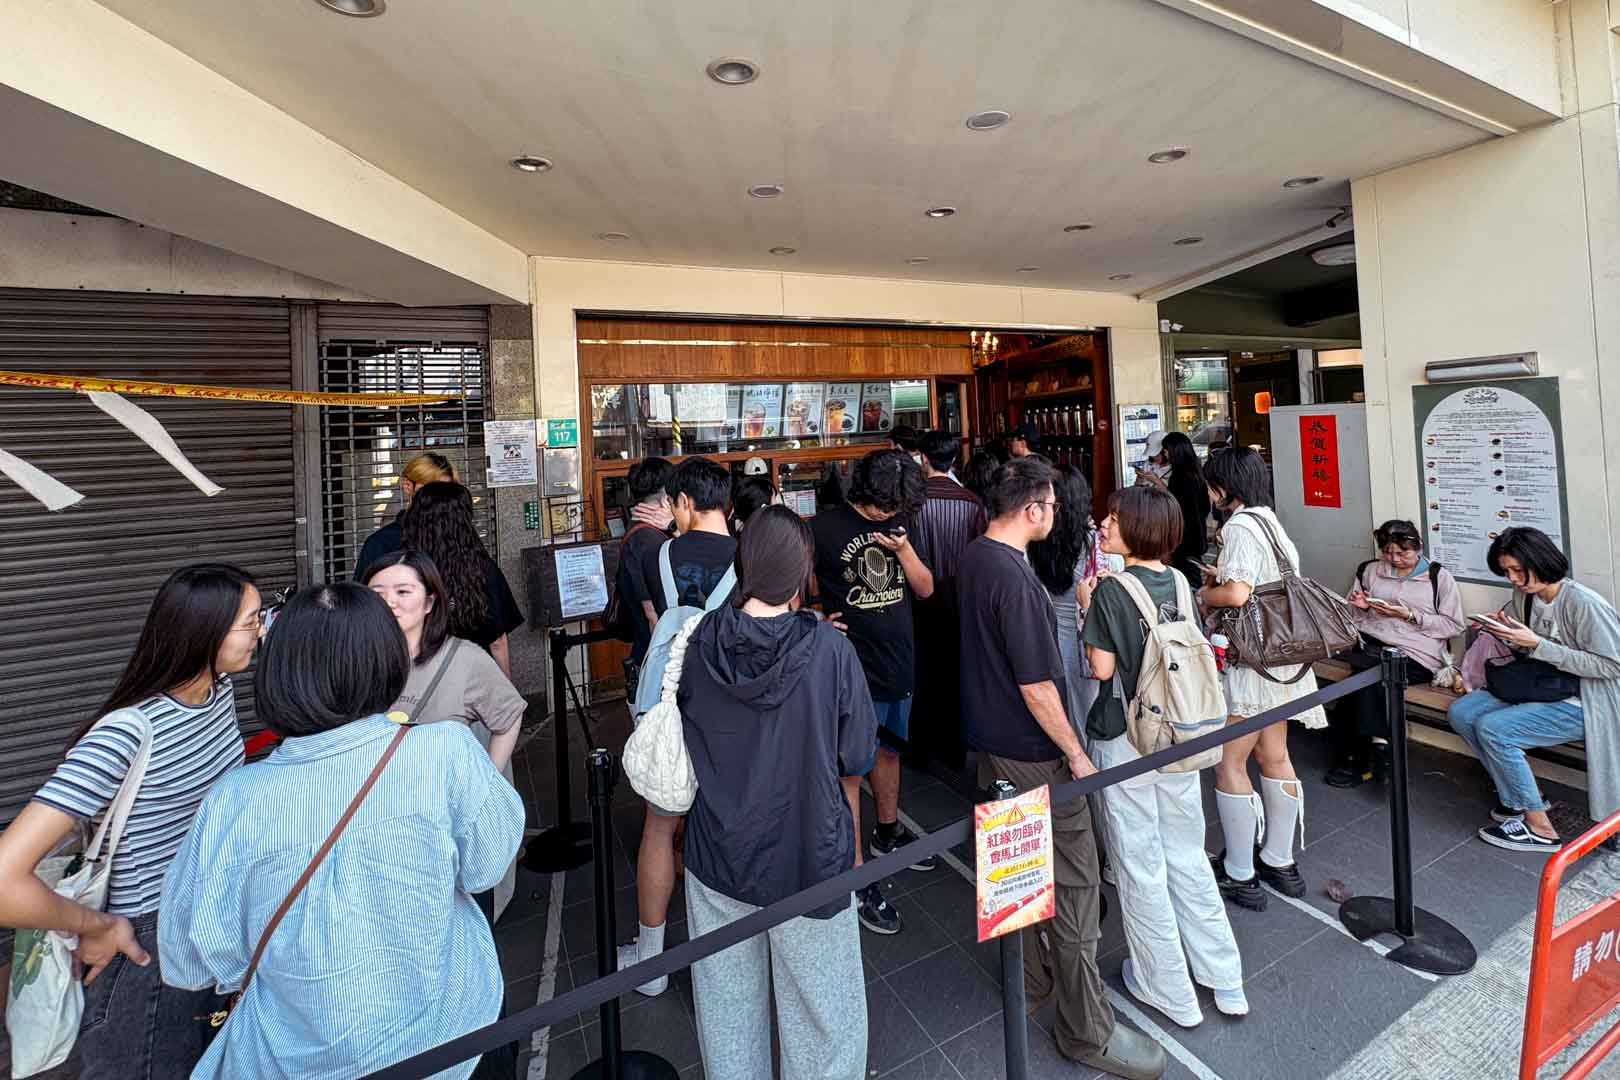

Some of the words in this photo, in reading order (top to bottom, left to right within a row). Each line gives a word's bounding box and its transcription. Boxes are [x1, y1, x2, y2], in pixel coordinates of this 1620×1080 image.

[554, 431, 571, 442] 117
[840, 532, 875, 563] WORLD
[986, 819, 1044, 849] 紅線勿臨停
[990, 837, 1041, 865] 會馬上開單
[1572, 930, 1615, 981] 請勿
